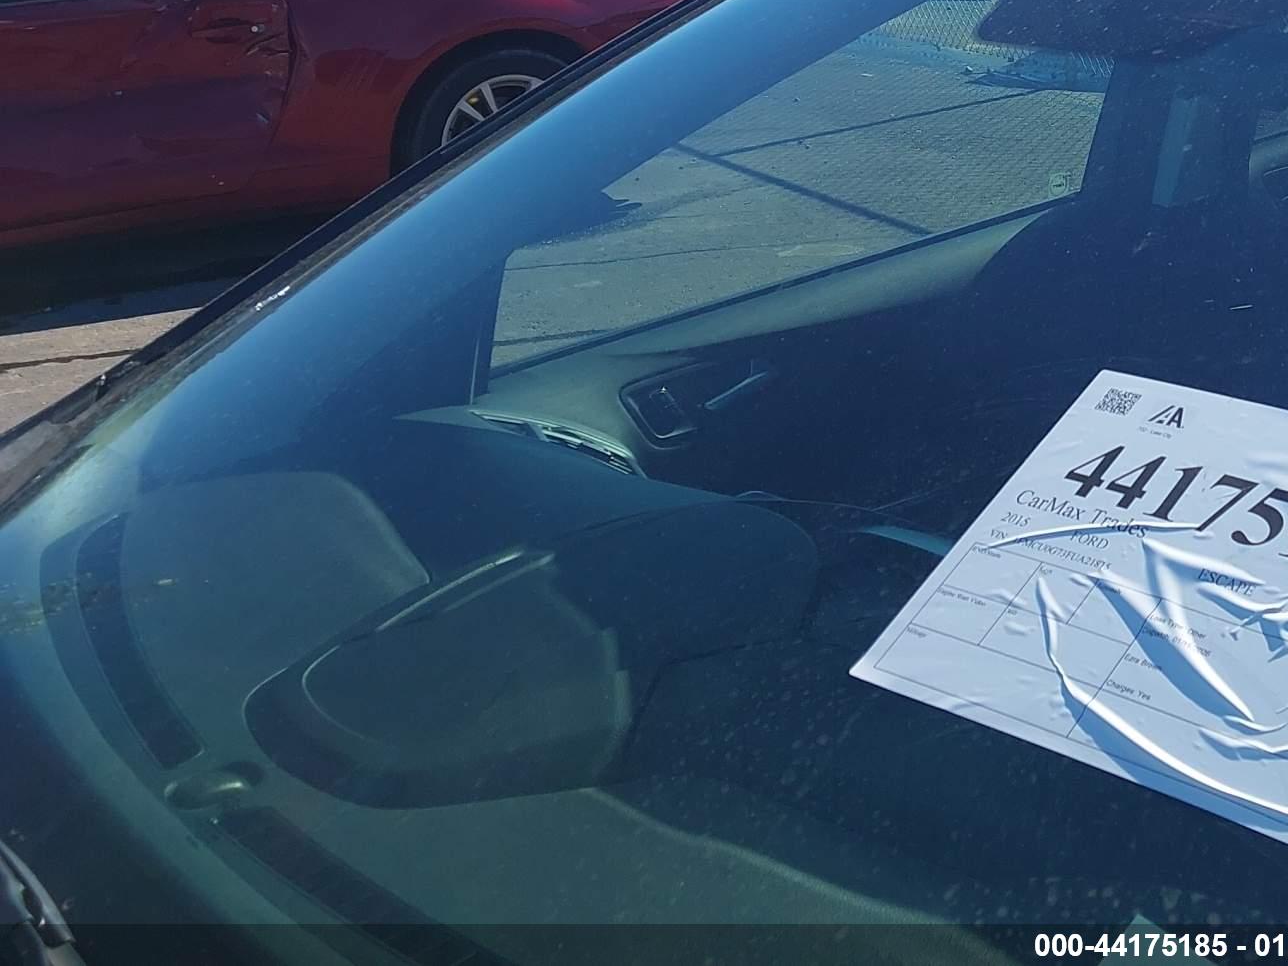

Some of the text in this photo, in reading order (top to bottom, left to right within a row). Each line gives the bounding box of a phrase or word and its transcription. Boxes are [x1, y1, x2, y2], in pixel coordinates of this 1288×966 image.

[1016, 489, 1149, 538] CarMax Trades
[1000, 511, 1256, 595] 2015 FORD ESCAPE
